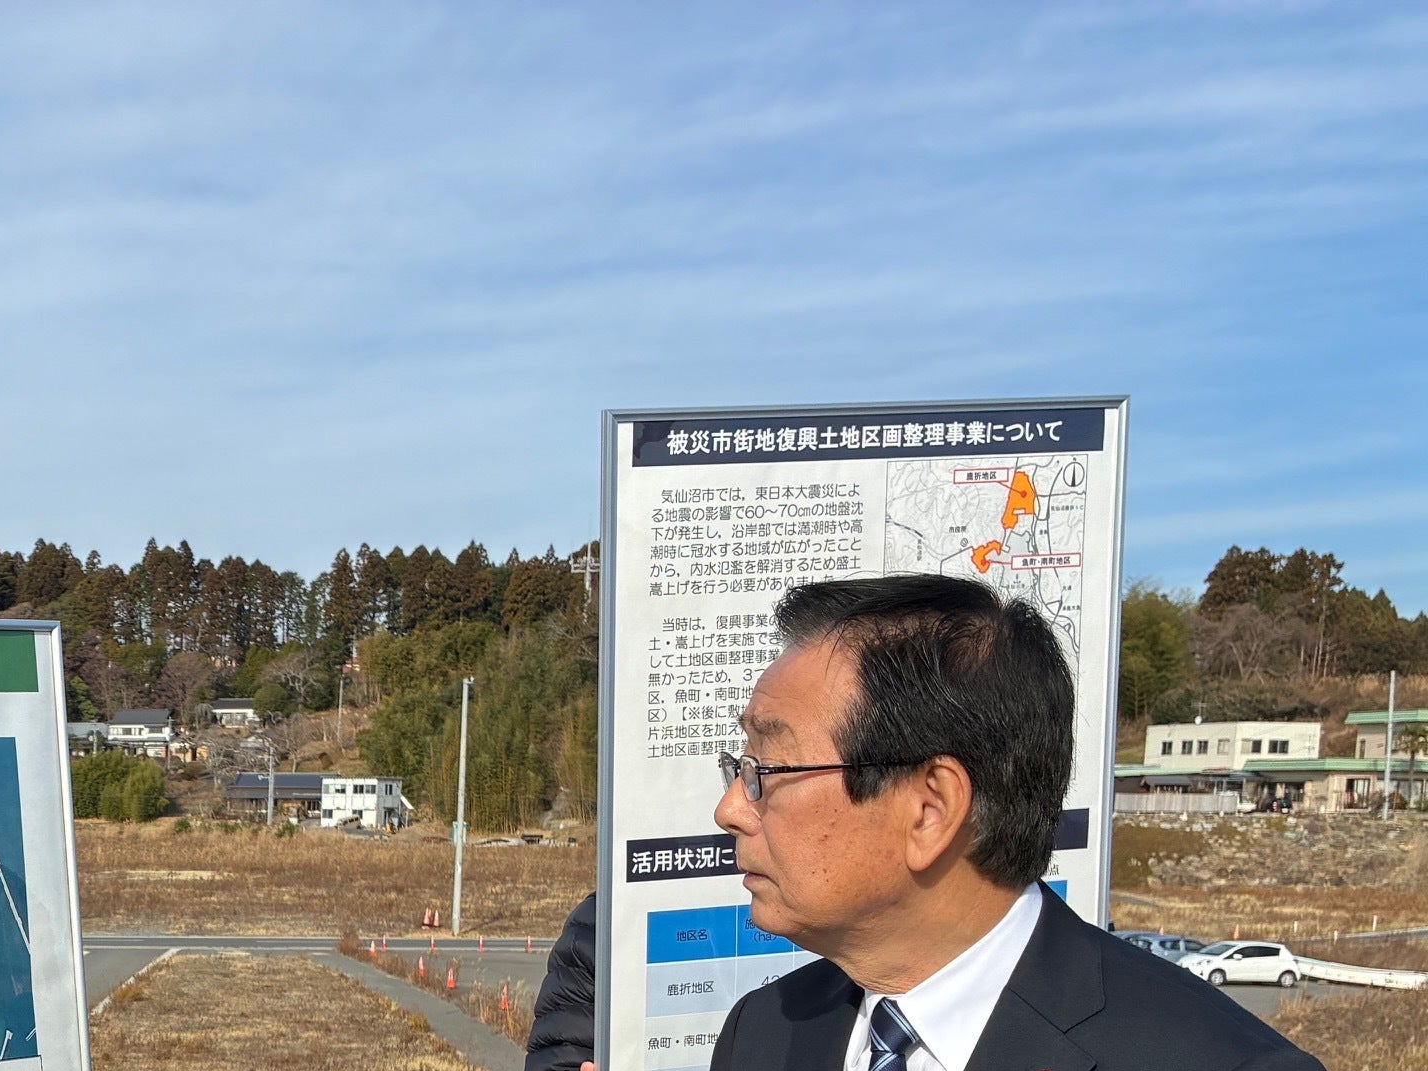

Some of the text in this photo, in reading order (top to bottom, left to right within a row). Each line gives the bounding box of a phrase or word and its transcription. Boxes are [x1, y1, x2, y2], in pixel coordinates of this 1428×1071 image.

[667, 421, 1063, 455] 被災市街地復興土地区画整理事業について
[661, 483, 860, 503] 気仙沼市では，東日本大震災によ
[651, 519, 863, 541] 下が発生し，沿岸部では満潮時や高
[650, 537, 862, 560] 潮時に冠水する地域が広がったこと
[650, 556, 861, 577] から，内水氾濫を解消するため盛土
[648, 722, 744, 740] 片浜地区を加え
[632, 847, 736, 874] 活用状況に
[676, 929, 708, 942] 地区名
[667, 981, 714, 996] 鹿折地区
